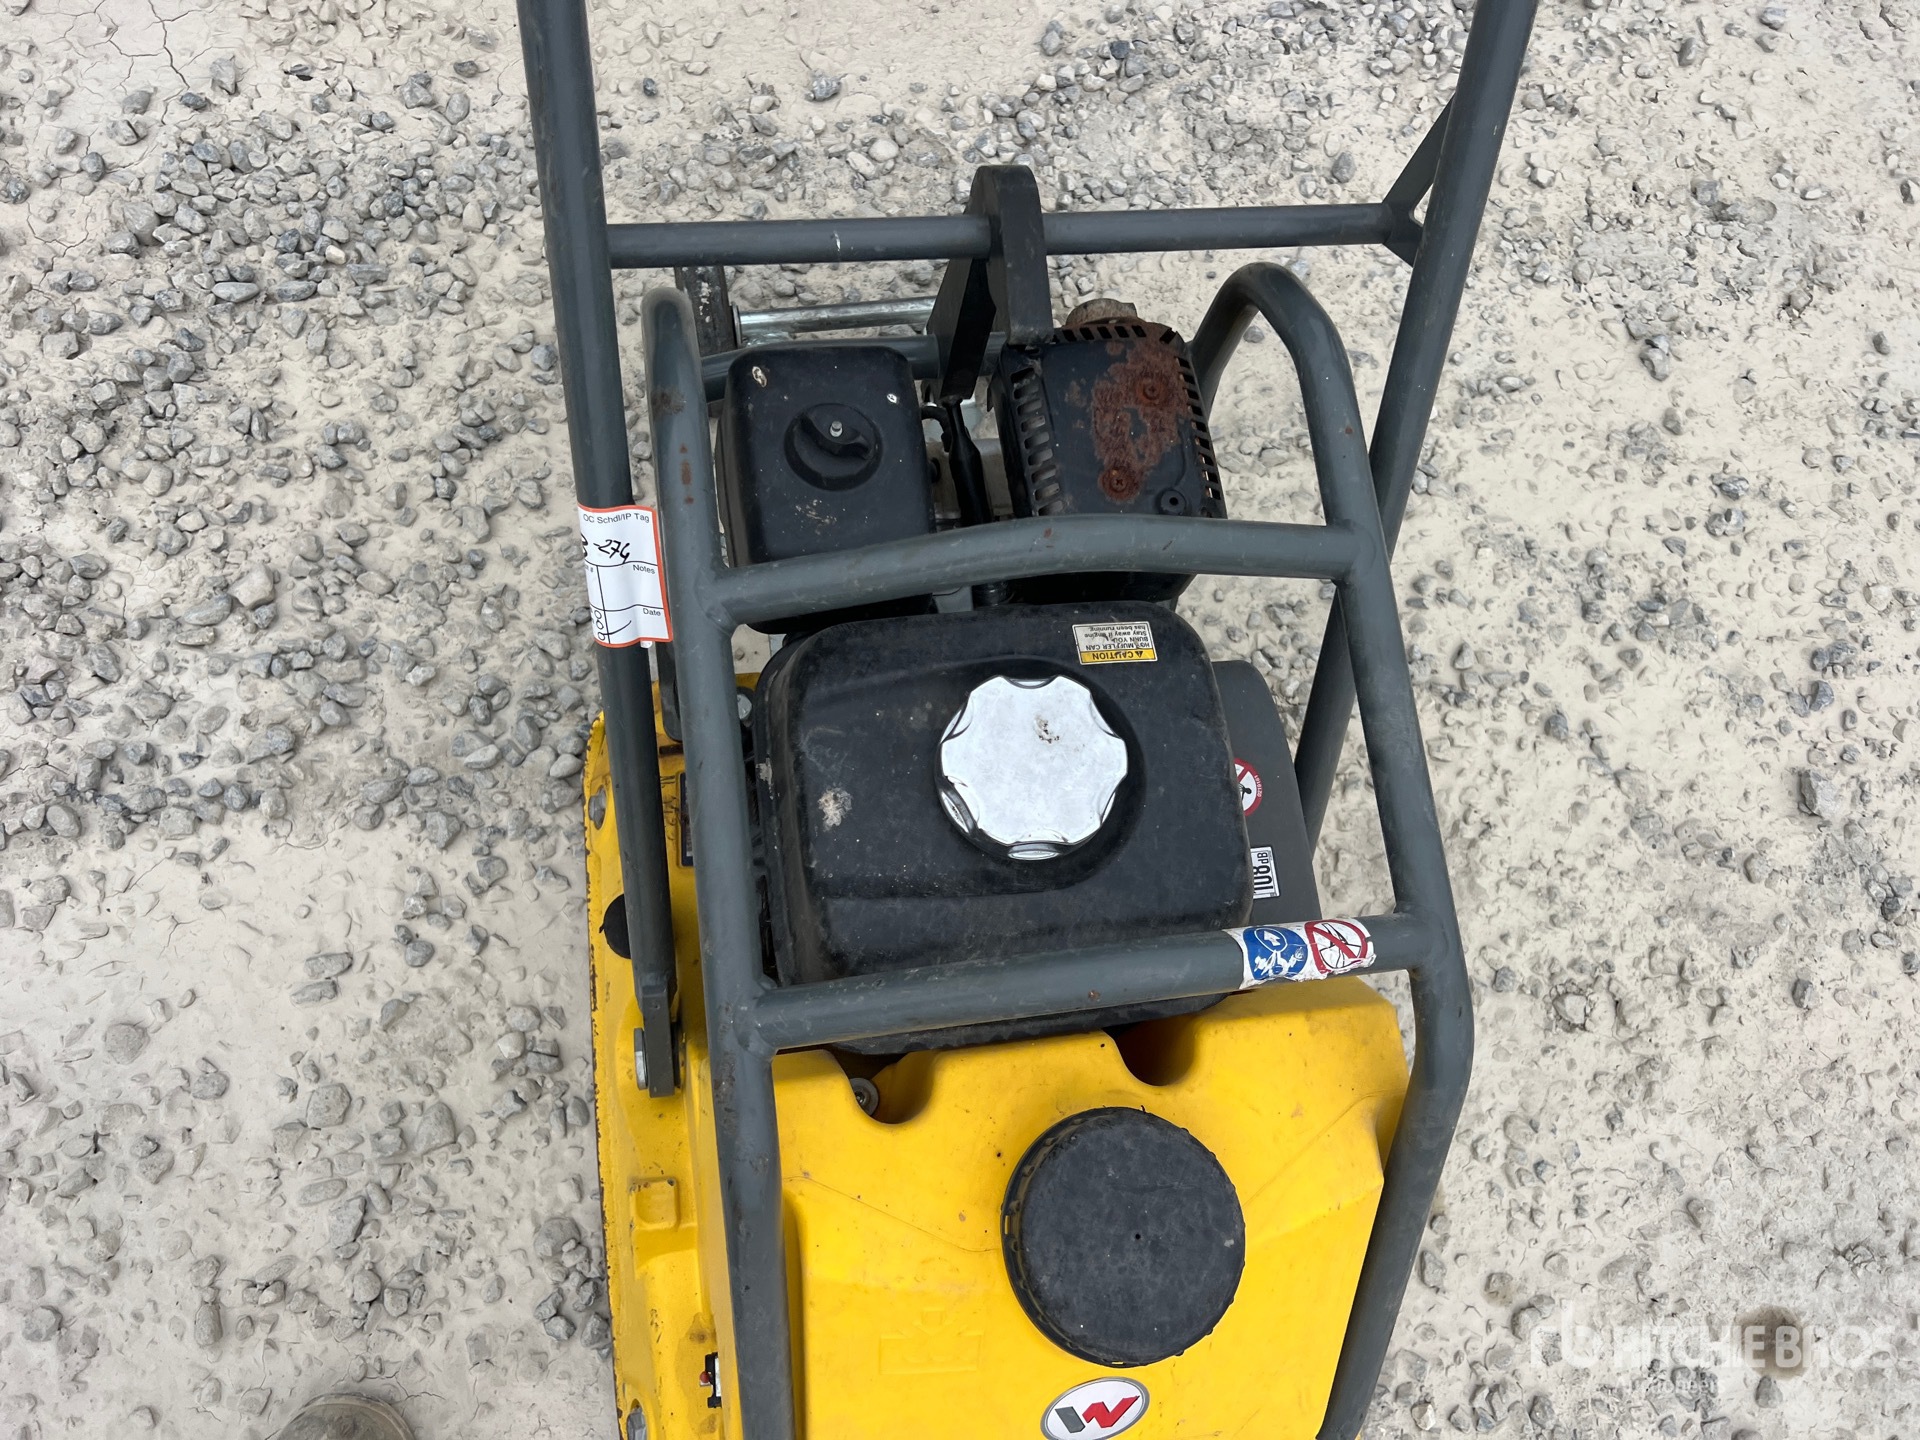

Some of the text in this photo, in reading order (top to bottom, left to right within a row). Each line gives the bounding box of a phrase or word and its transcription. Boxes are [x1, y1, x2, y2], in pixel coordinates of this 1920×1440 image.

[634, 513, 649, 523] Tag
[633, 564, 656, 574] Notes
[643, 608, 661, 616] Date
[1092, 650, 1134, 660] CAUTION
